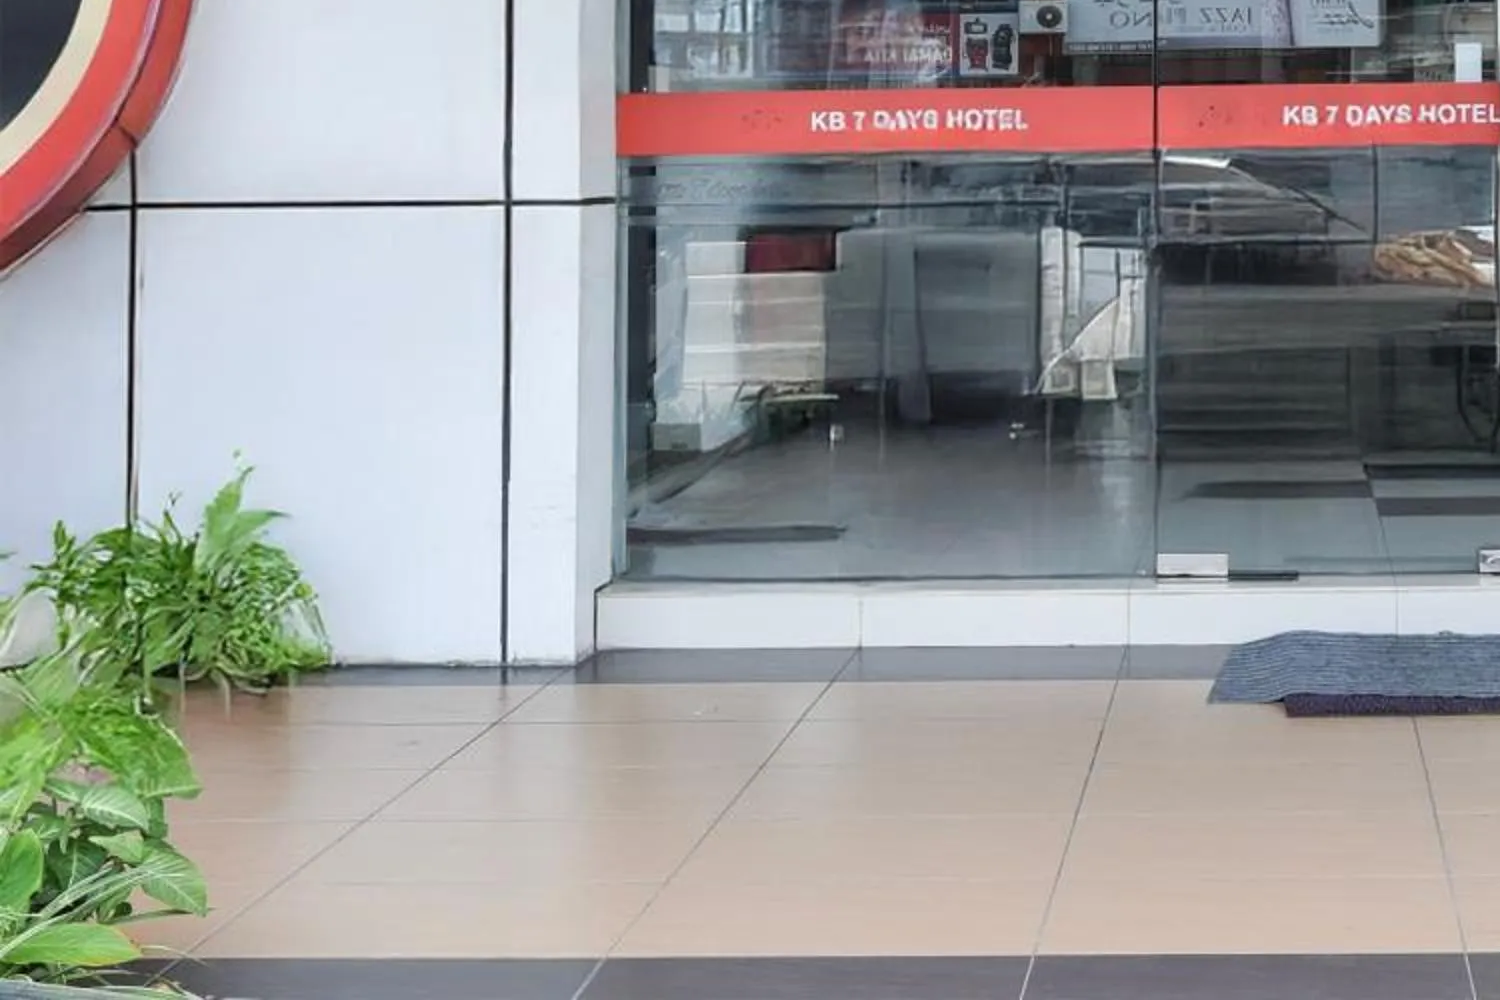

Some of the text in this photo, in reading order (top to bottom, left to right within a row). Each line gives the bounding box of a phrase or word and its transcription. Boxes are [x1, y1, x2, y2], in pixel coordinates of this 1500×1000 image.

[811, 111, 847, 132] KB
[853, 111, 867, 131] 7
[946, 108, 1029, 131] HOTEL
[1282, 105, 1319, 126] KB
[1326, 105, 1339, 125] 7
[1345, 104, 1412, 127] DAYS
